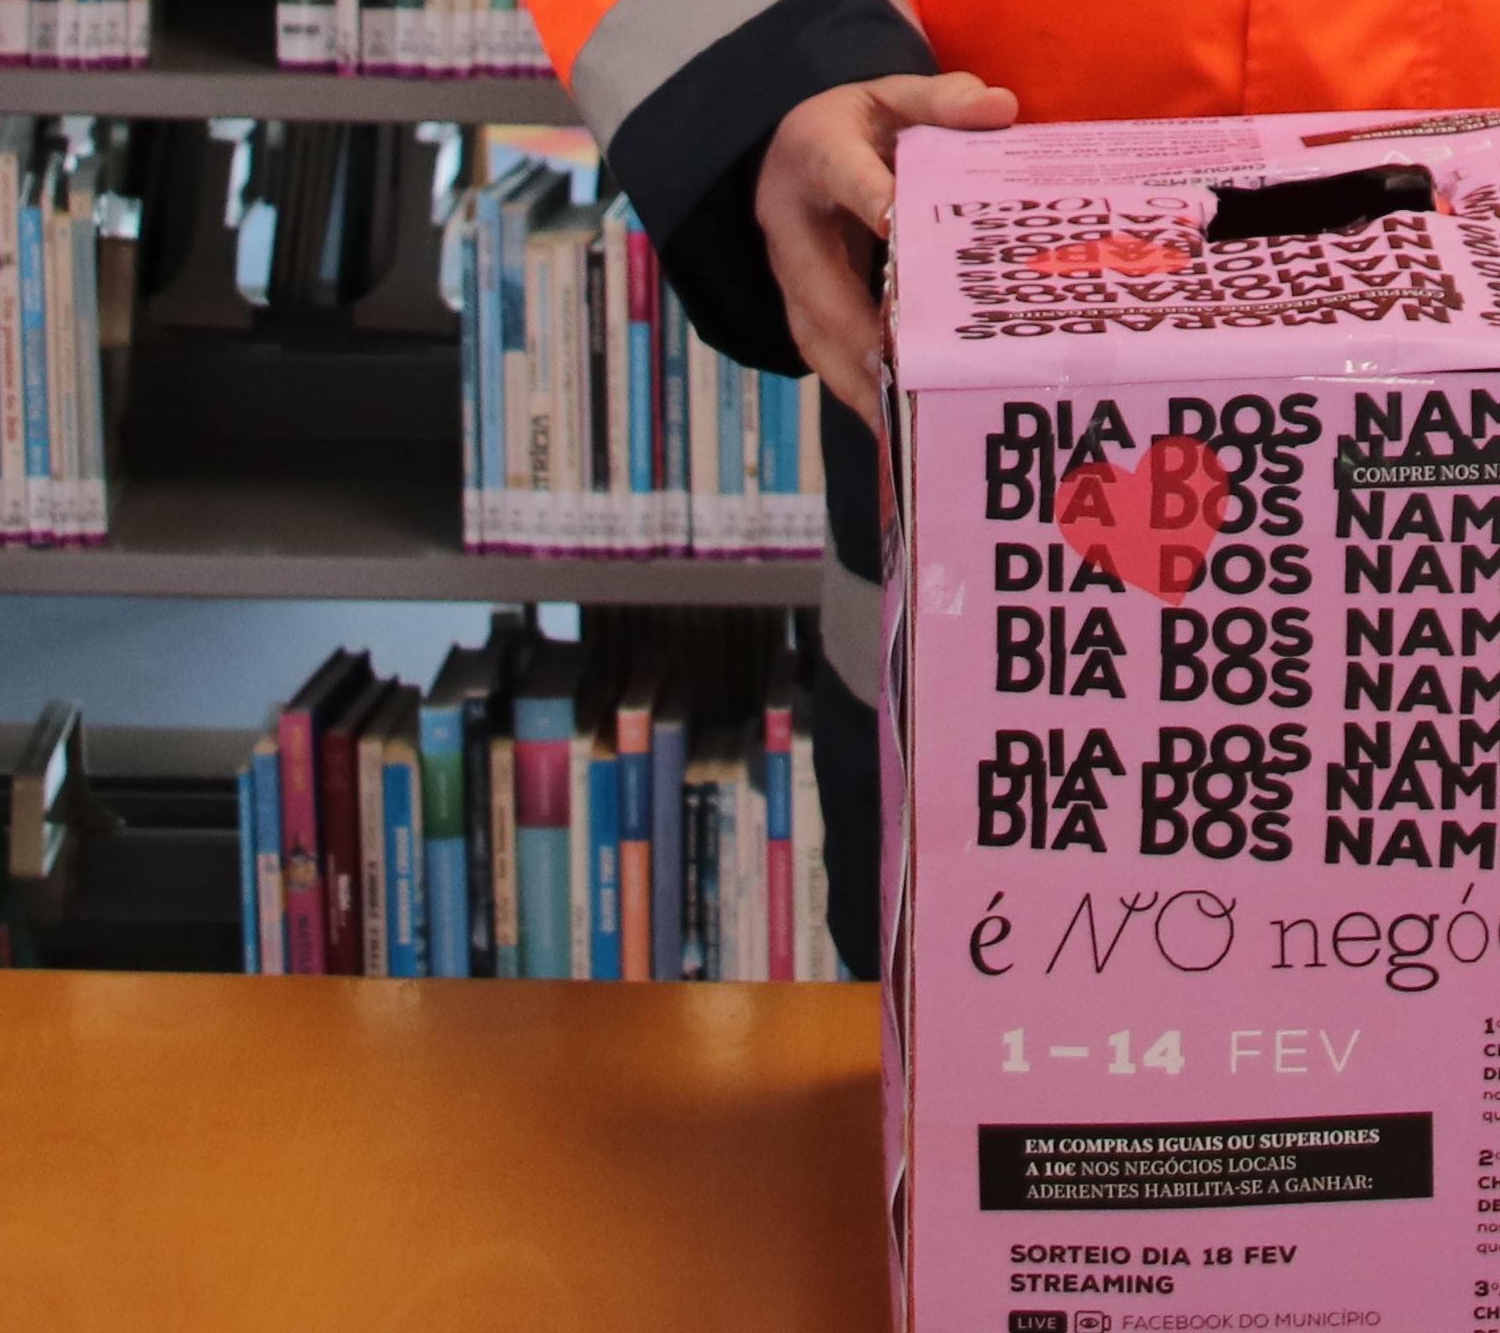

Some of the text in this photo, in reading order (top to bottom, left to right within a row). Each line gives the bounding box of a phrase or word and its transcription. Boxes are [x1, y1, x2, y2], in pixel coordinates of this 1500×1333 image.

[1003, 400, 1135, 450] DIA
[1168, 393, 1322, 447] DOS
[985, 433, 1116, 483] DIA
[1151, 432, 1304, 485] DOS
[1352, 464, 1437, 485] COMPRE
[1439, 462, 1481, 482] NOS
[985, 475, 1116, 527] DIA
[1150, 480, 1304, 536] DOS
[995, 543, 1126, 593] DIA
[1159, 543, 1312, 595] DOS
[996, 606, 1127, 655] DIA
[1160, 607, 1314, 657] DOS
[995, 648, 1126, 699] DIA
[1159, 655, 1312, 708] DOS
[995, 728, 1127, 777] DIA
[1158, 723, 1312, 774] DOS
[978, 760, 1108, 810] DIA
[1141, 760, 1293, 811] DOS
[977, 801, 1108, 853] DIA
[1140, 807, 1293, 861] DOS
[968, 890, 1015, 977] é
[1045, 889, 1237, 975] NO
[1230, 1028, 1361, 1074] FEV
[1024, 1129, 1380, 1154] EM COMPRAS IGUAIS OU SUPERIORES
[1025, 1155, 1297, 1177] A 10€ NOS NEGÓCIOS LOCAIS
[1026, 1174, 1373, 1200] ADERENTES HABILITA-SE A GANHAR:
[1010, 1244, 1298, 1265] SORTEIO DIA 18 FEV
[1010, 1273, 1175, 1294] STREAMING
[1017, 1308, 1382, 1330] LIVE FACEBOOK DO MUNICÍPIO
